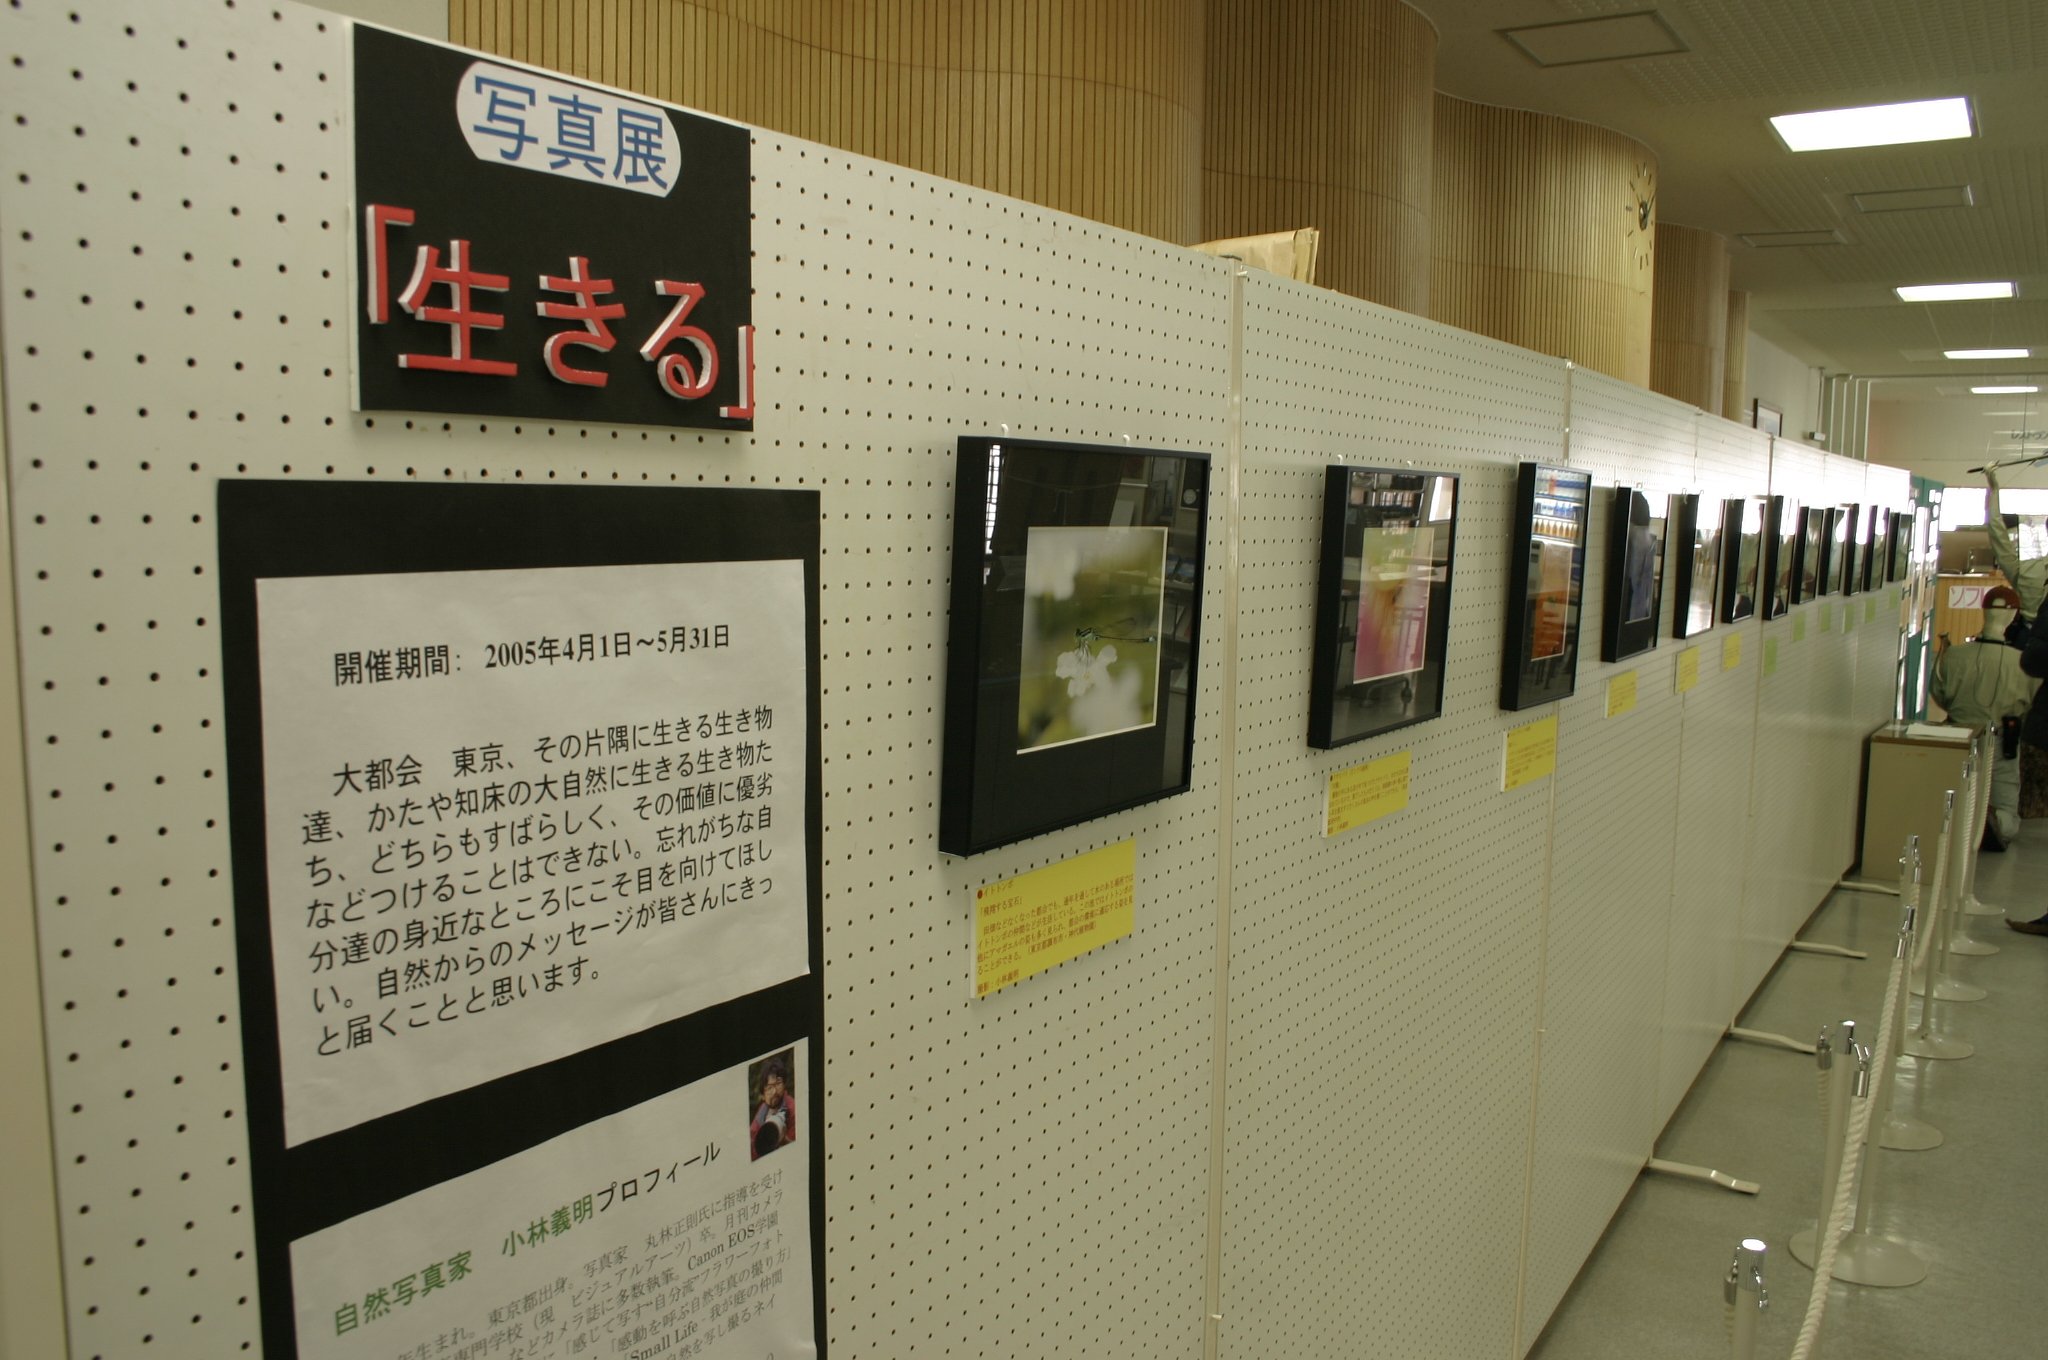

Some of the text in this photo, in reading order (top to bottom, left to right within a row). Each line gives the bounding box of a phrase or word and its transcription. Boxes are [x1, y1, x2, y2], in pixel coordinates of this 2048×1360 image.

[473, 74, 669, 190] 写真展
[366, 204, 754, 421] 「生きる」
[484, 624, 731, 670] 2005年4月1日～5月31日
[302, 740, 774, 845] 達、かたや知床の大自然に生きる生き物た
[332, 704, 774, 797] 大都会 東京、その片隅に生きる生き物
[305, 775, 774, 887] ち、どちらもすばらしく、その価値に優劣
[306, 804, 773, 928] などつけることはできない。忘れがちな自
[308, 839, 773, 973] 分達の身近なところにこそ目を向けてほし
[312, 873, 773, 1012] い。自然からのメッセージが皆さんにきっ
[316, 955, 606, 1056] と届くことと思います。
[334, 1142, 722, 1338] 自然写真家 小林義明プロフィール
[674, 1320, 698, 1344] Life
